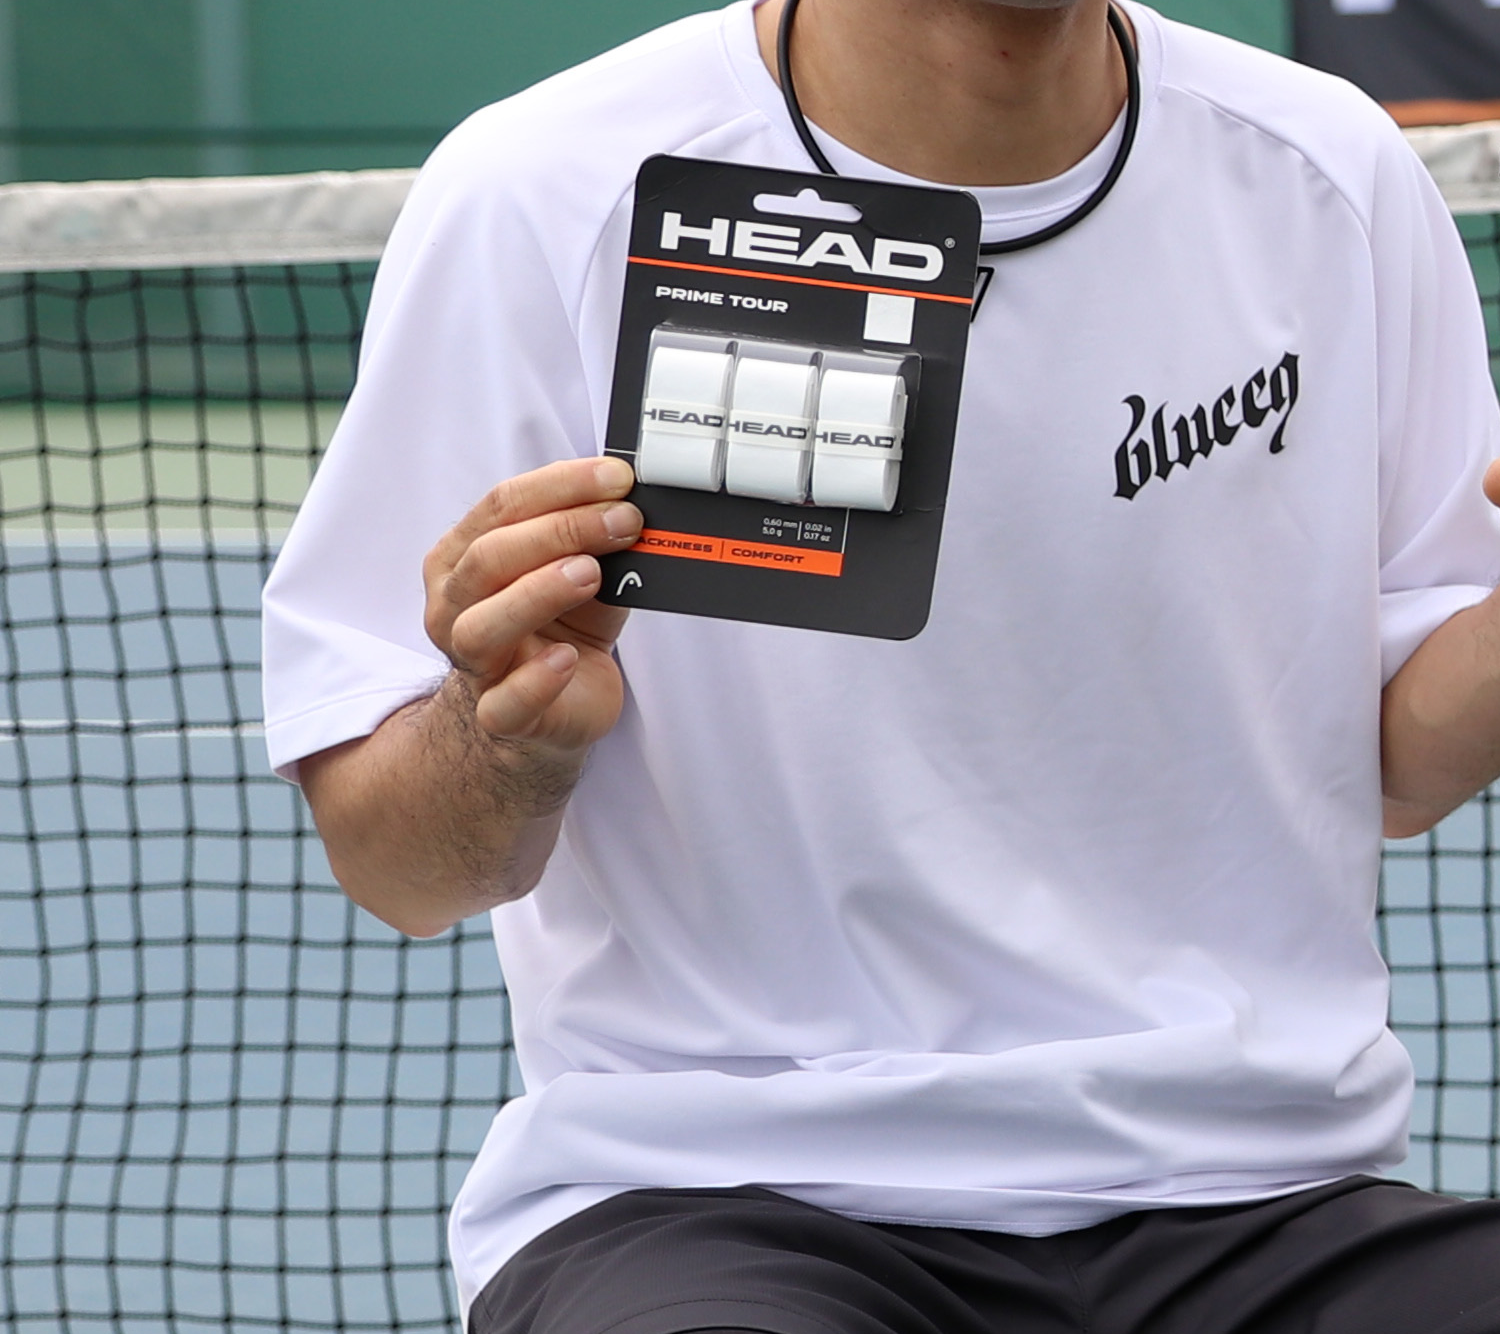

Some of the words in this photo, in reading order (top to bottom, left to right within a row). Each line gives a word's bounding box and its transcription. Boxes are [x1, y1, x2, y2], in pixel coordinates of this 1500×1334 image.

[659, 210, 944, 282] HEAD
[655, 285, 724, 307] PRIME
[729, 292, 789, 313] TOUR
[638, 536, 713, 553] ACKINESS
[731, 547, 805, 564] COMFORT
